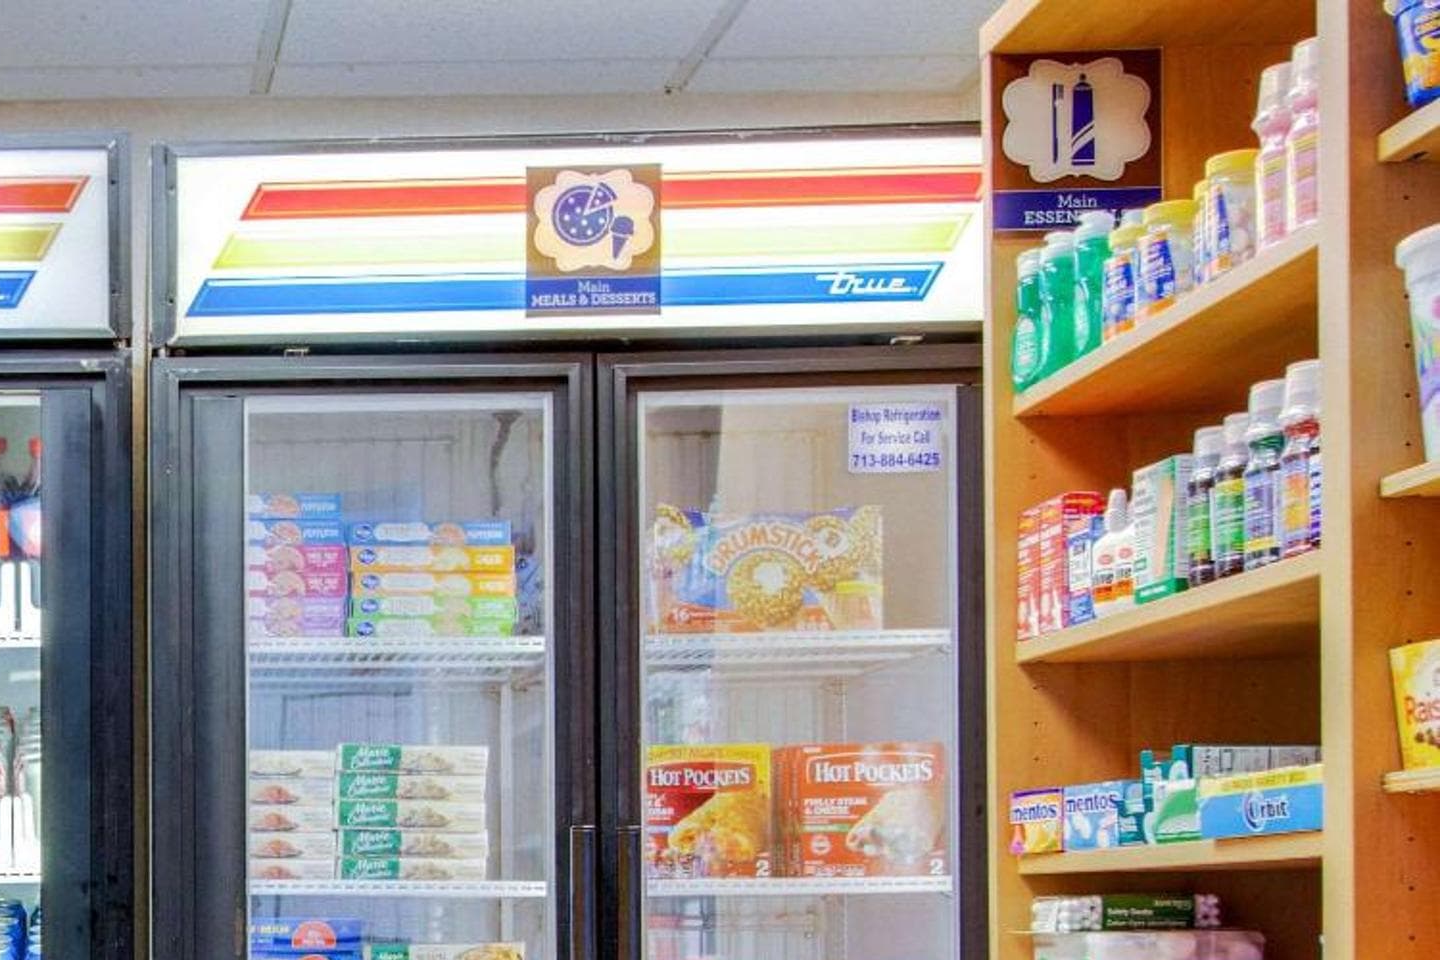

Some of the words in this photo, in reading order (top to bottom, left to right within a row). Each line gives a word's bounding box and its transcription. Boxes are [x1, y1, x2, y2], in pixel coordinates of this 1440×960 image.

[1057, 195, 1098, 208] Main
[577, 280, 610, 293] Main
[531, 294, 576, 307] MEALS
[579, 294, 588, 306] &
[591, 292, 656, 306] DESSERTS
[851, 408, 881, 423] Bishop
[884, 408, 941, 423] Refrigeration
[861, 431, 875, 444] For
[877, 431, 911, 444] Service
[913, 431, 931, 444] Call
[852, 453, 940, 467] 713-884-6425
[708, 521, 822, 576] DRUMSTICK
[650, 770, 681, 786] HOT
[684, 768, 750, 786] POCKETS
[815, 765, 851, 783] HOT
[854, 761, 933, 783] POCKETS
[1066, 790, 1118, 813] mentos
[1010, 803, 1058, 821] mentos
[1245, 793, 1289, 829] Orbit
[755, 859, 769, 876] 2
[930, 858, 944, 875] 2
